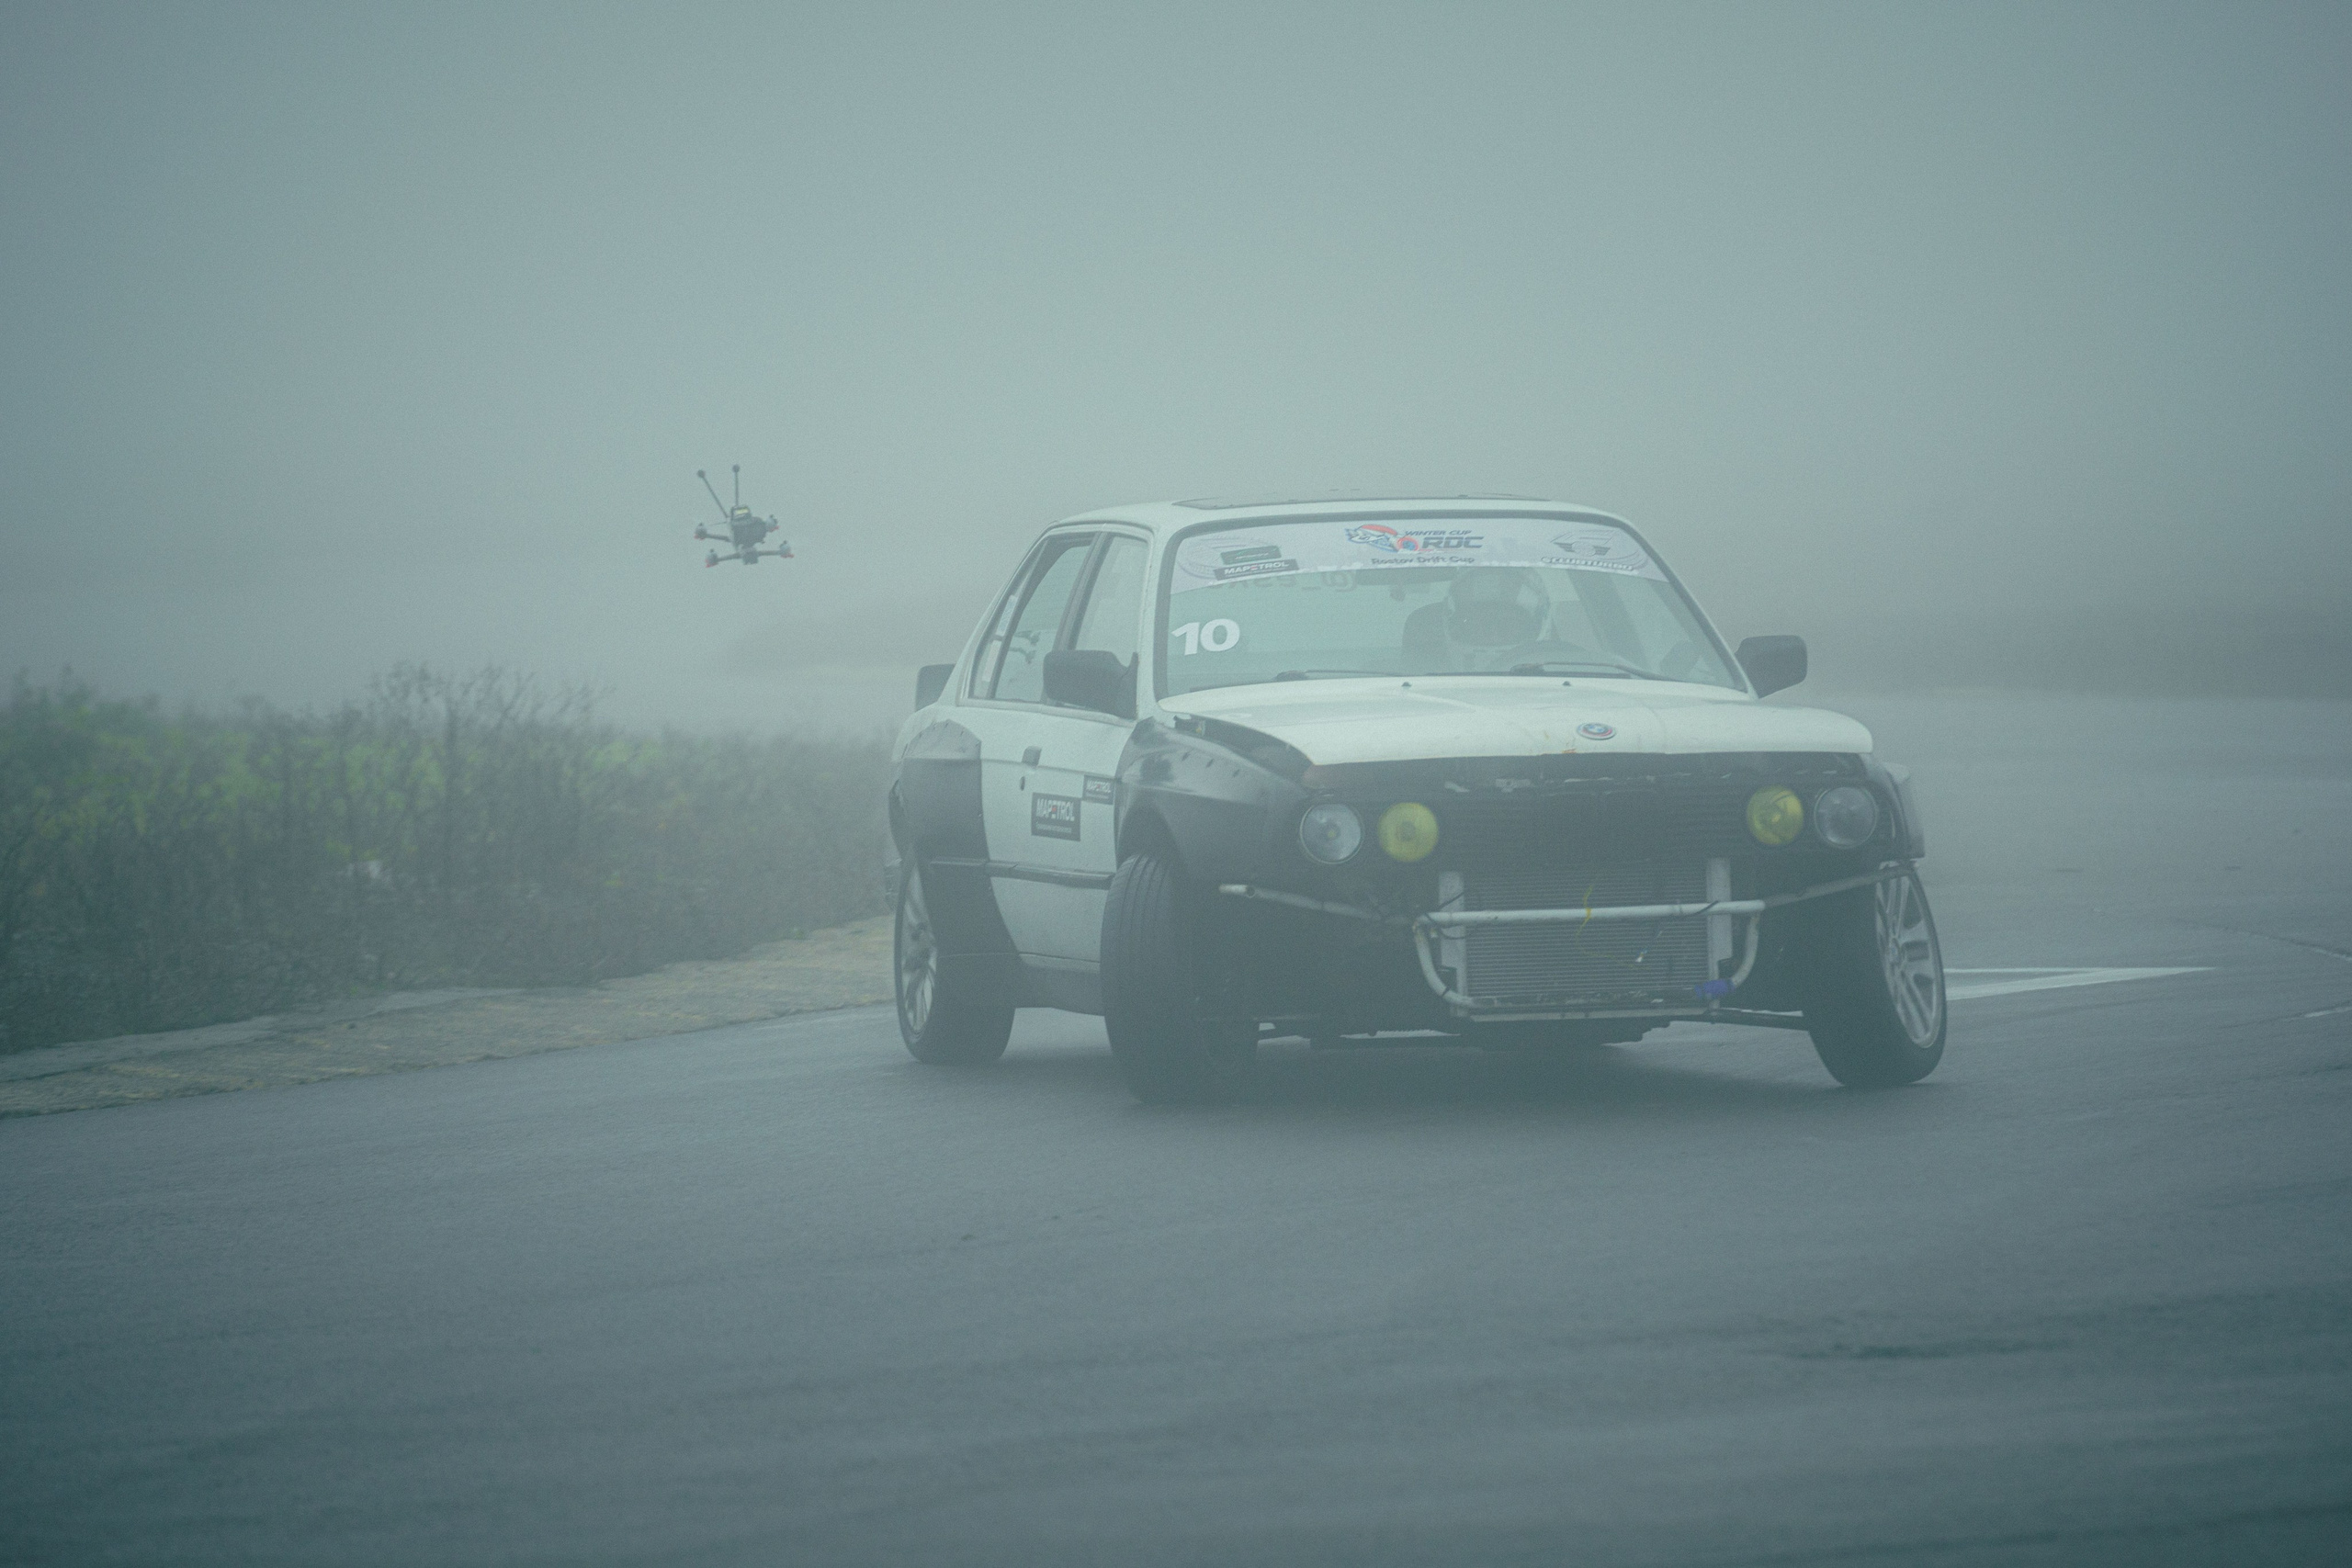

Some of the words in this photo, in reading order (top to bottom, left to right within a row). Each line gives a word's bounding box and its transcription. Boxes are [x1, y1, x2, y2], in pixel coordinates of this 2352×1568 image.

[1422, 536, 1485, 549] RDC
[1224, 560, 1290, 575] MAPETROL
[1417, 556, 1447, 564] Drift
[1450, 556, 1476, 564] Cup
[1171, 618, 1240, 656] 10
[1035, 798, 1075, 821] MAPETROL
